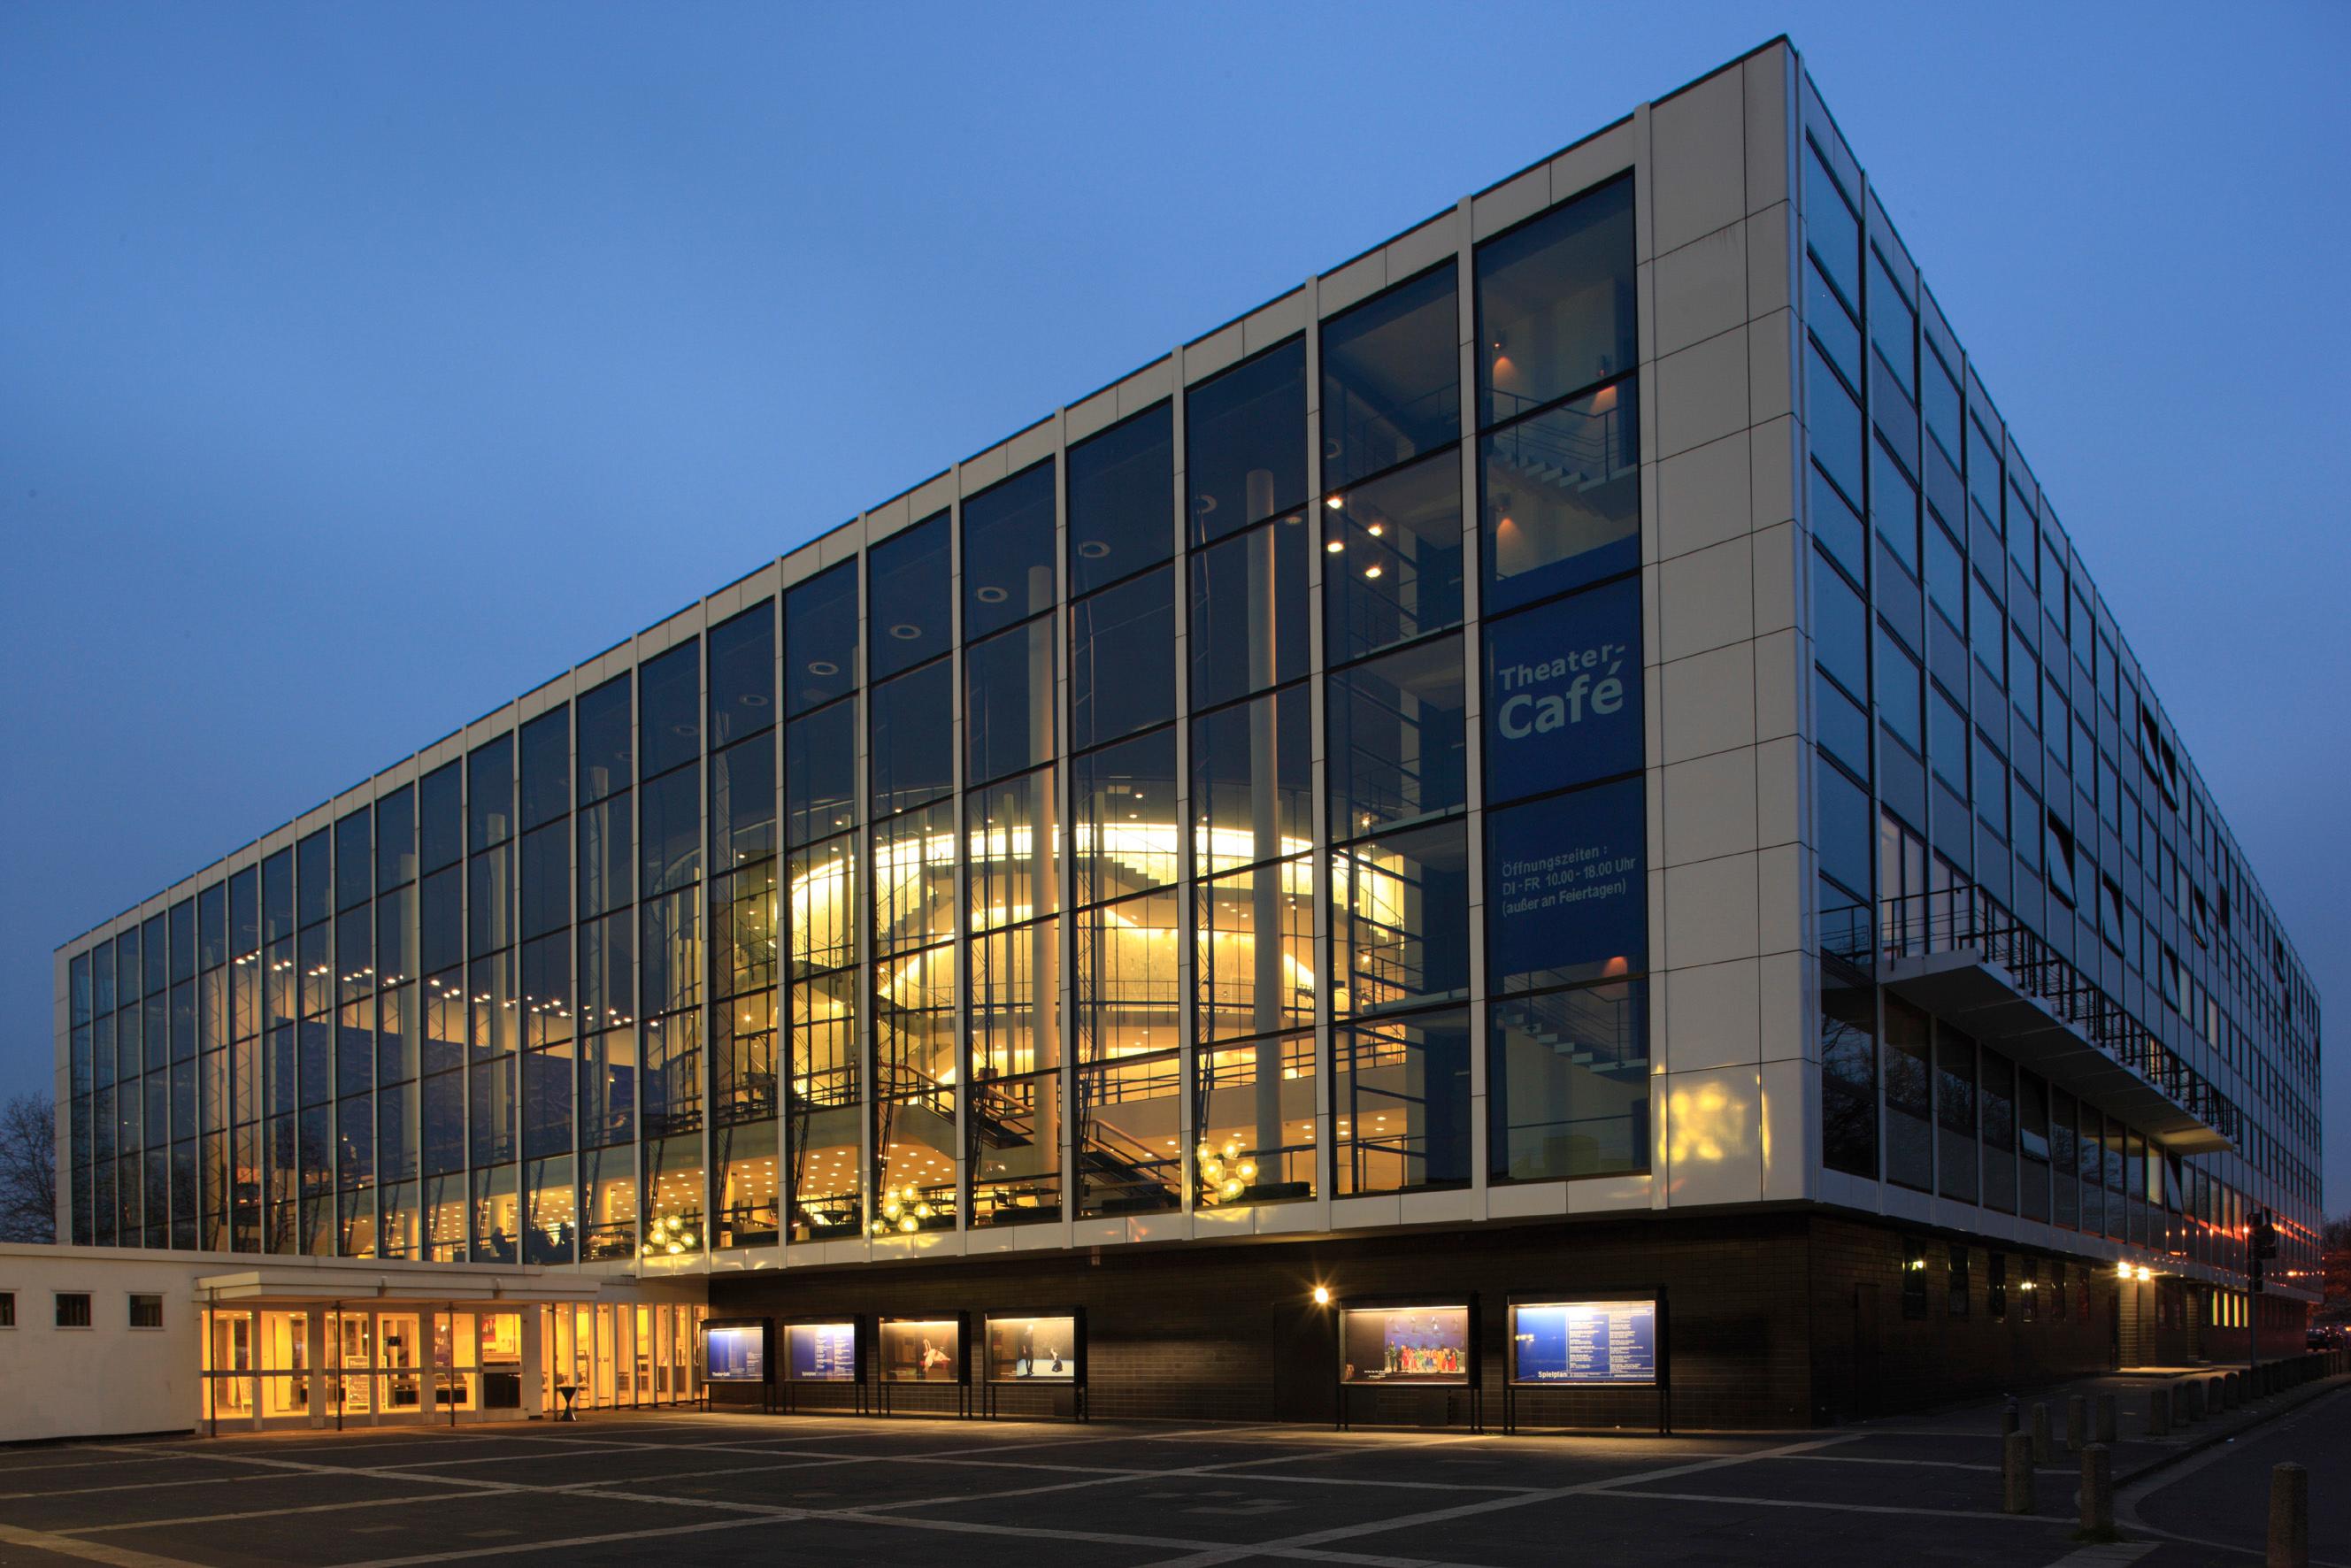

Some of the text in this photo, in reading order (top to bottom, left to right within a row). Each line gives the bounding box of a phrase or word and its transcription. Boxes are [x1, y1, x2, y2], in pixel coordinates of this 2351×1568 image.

[1499, 644, 1625, 690] Theater-
[1499, 660, 1623, 740] Café
[1502, 848, 1600, 877] Öffnungszeiten
[1615, 857, 1636, 872] Uhr
[1502, 878, 1626, 918] (außer an Feiertagen)
